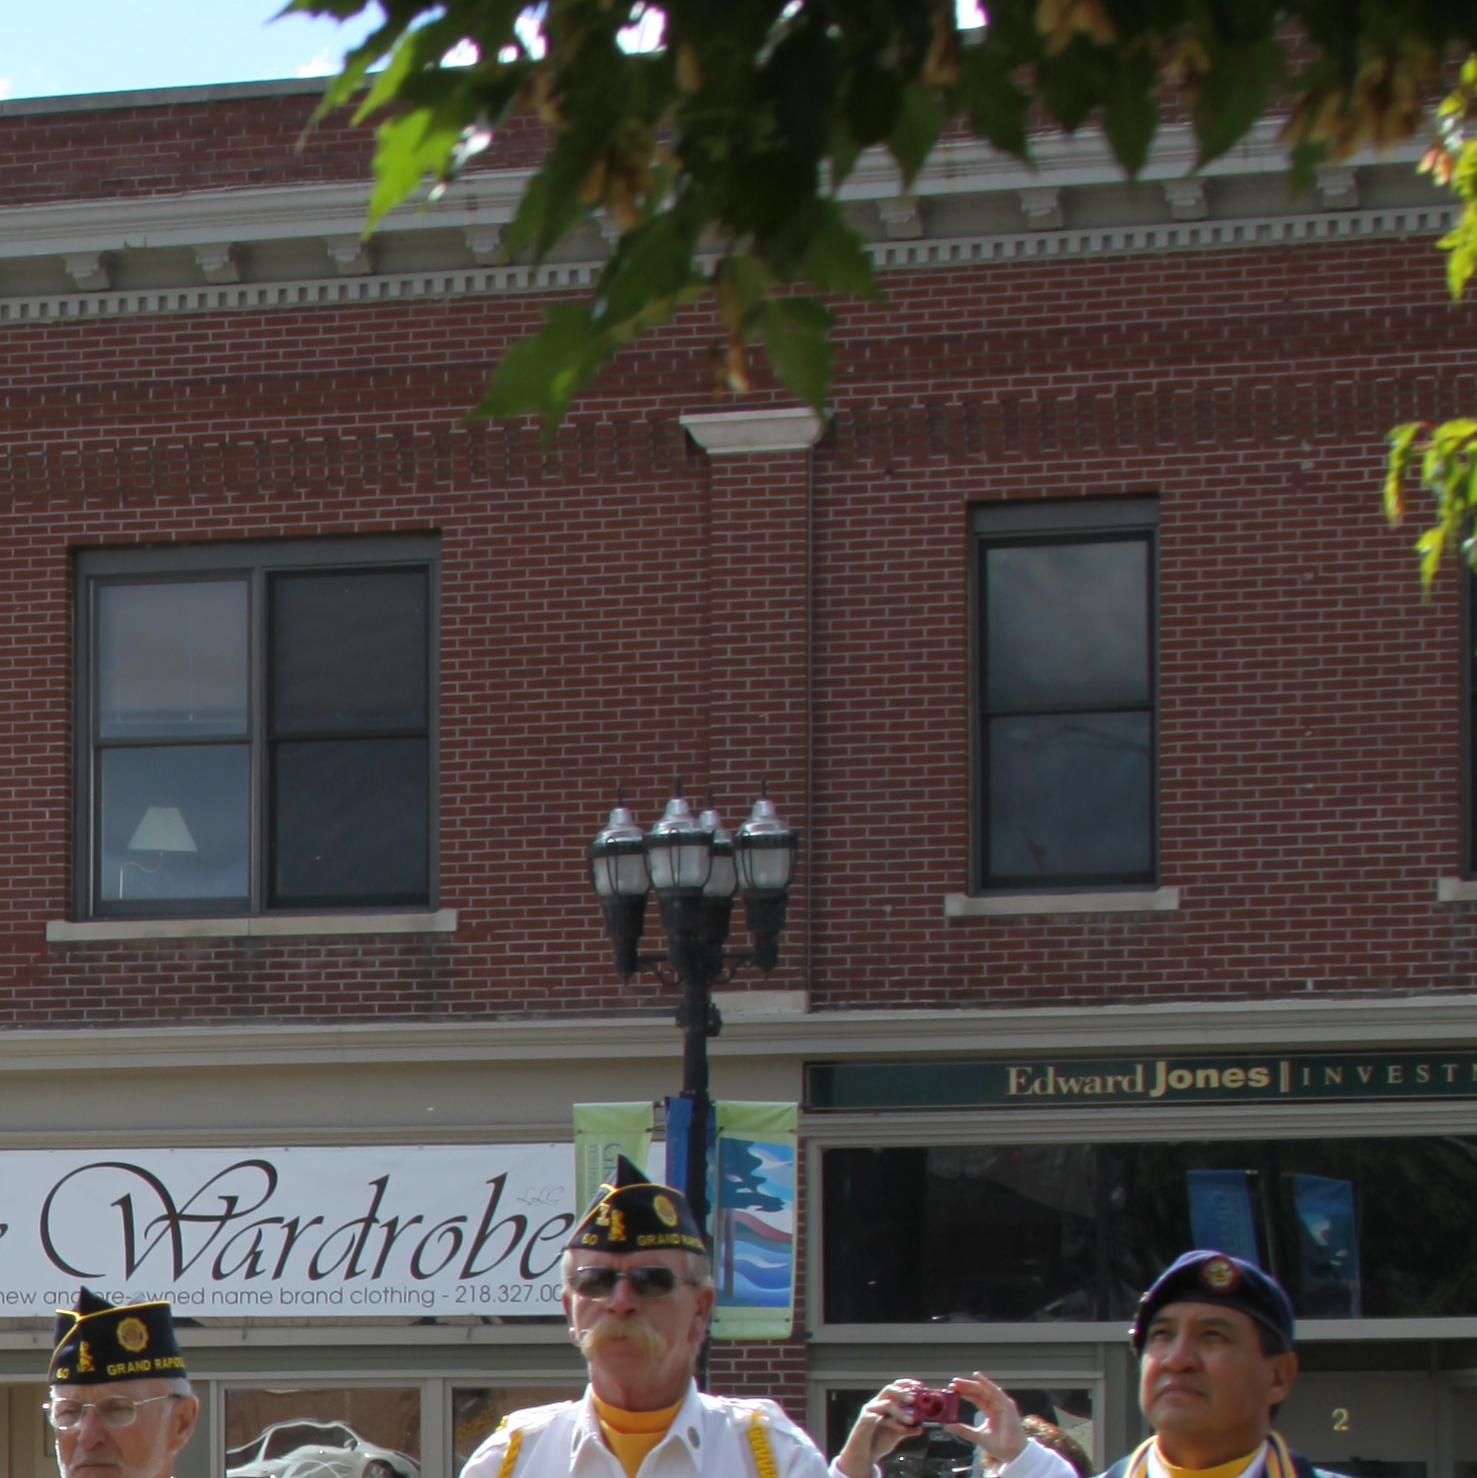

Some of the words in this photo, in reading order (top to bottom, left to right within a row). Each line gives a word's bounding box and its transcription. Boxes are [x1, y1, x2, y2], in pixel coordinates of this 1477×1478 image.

[1005, 1064, 1143, 1096] Edward
[1150, 1060, 1269, 1097] Jones
[1302, 1063, 1477, 1085] INVEST
[39, 1158, 576, 1284] Wardrobe
[581, 1233, 599, 1245] 60
[637, 1234, 681, 1246] GRAND
[212, 1290, 273, 1305] name
[280, 1286, 343, 1305] brand
[350, 1286, 435, 1308] clothing
[106, 1359, 151, 1376] GRAND
[1332, 1408, 1349, 1431] 2
